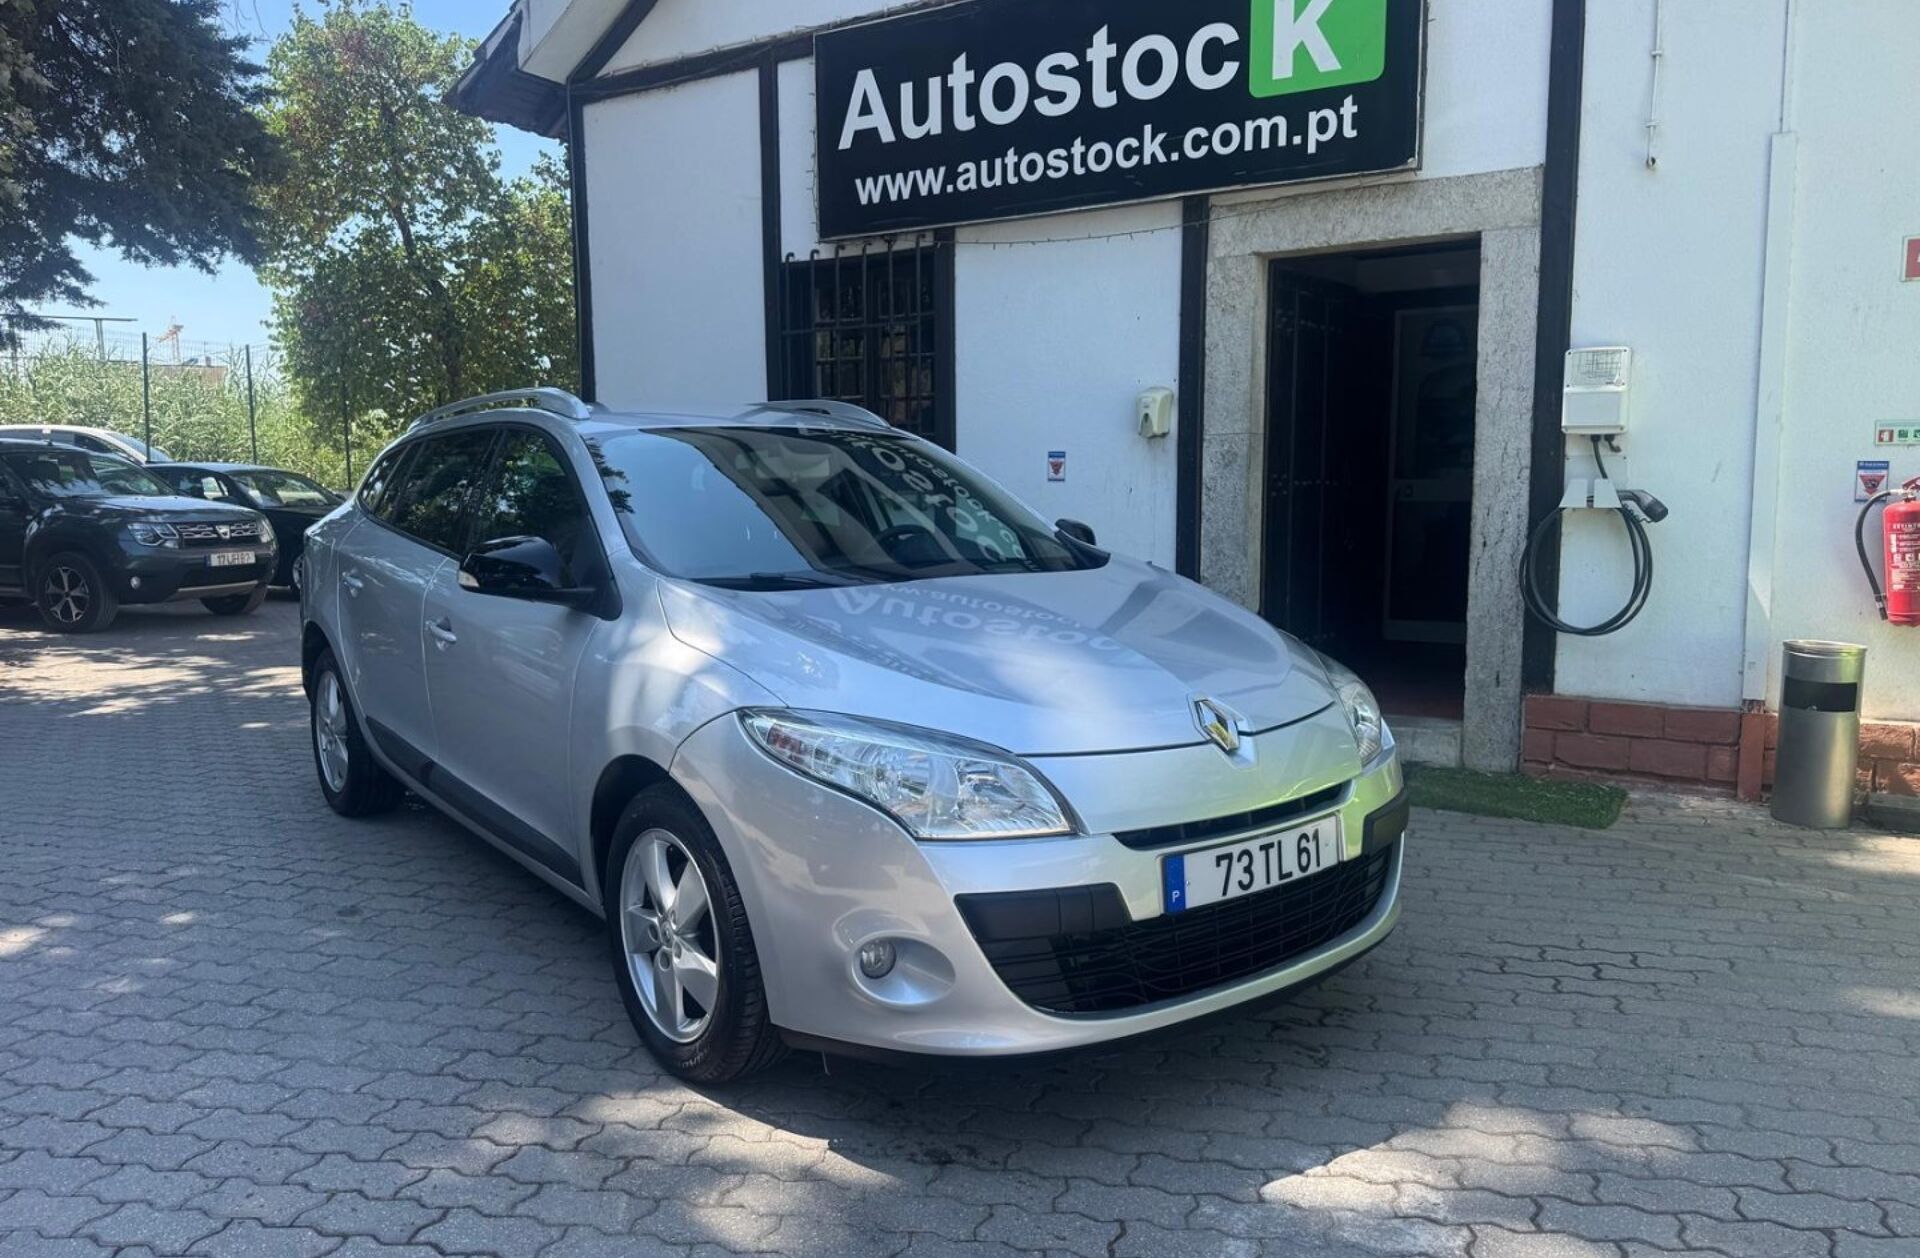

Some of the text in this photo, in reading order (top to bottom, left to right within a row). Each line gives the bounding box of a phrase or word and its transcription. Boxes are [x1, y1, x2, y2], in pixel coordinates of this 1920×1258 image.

[855, 95, 1358, 205] www.autostock.com.pt
[1171, 891, 1180, 902] P
[1215, 828, 1322, 897] 73TL61
